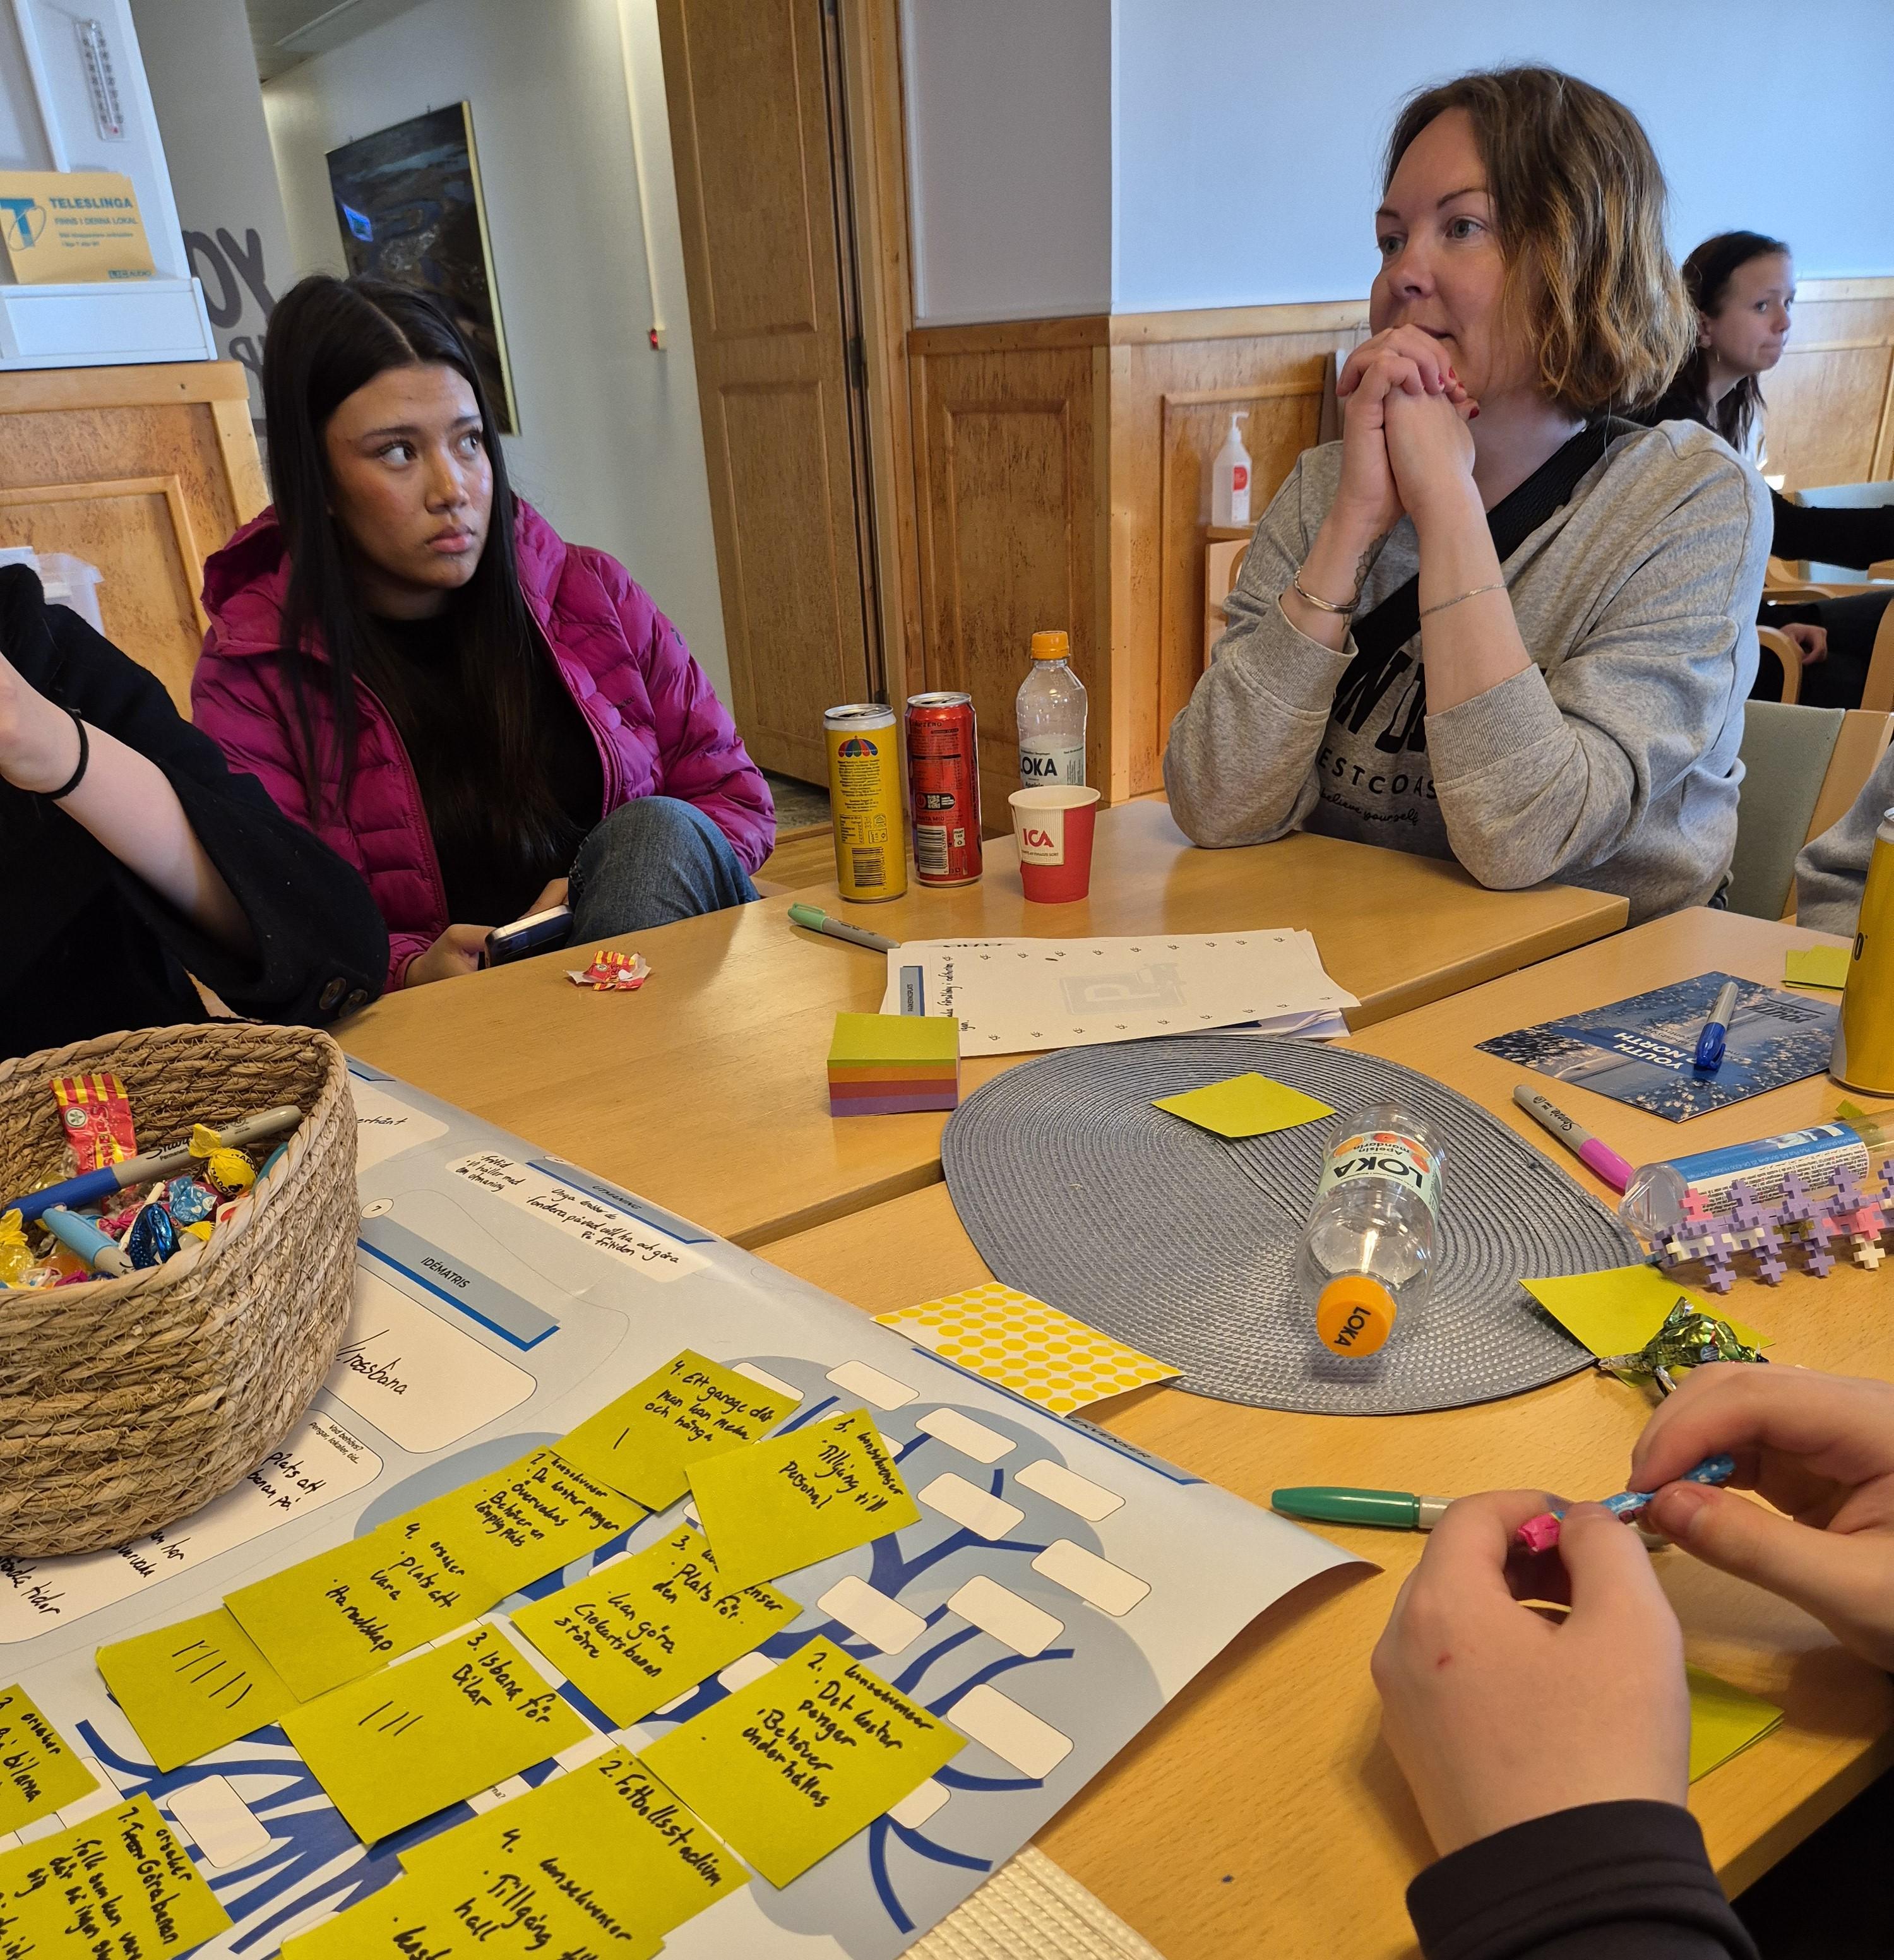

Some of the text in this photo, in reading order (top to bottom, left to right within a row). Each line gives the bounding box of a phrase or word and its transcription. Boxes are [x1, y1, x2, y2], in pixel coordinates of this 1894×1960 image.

[49, 198, 133, 209] TELESLINGA
[1021, 756, 1058, 776] OKA
[1318, 747, 1438, 799] ESTCOAS
[1364, 808, 1419, 826] yourself
[1023, 828, 1054, 847] ICA
[1613, 1033, 1688, 1059] NORTH
[1613, 1043, 1684, 1070] YOUTH
[1353, 1141, 1410, 1153] mandarin
[1359, 1146, 1403, 1155] Apelsin
[1333, 1156, 1423, 1189] LOKA
[592, 1185, 642, 1209] UTMANING
[420, 1257, 471, 1289] IDÉMATRIS
[1335, 1306, 1372, 1347] LOKA
[336, 1329, 410, 1396] rossbana
[645, 1401, 670, 1419] och
[697, 1385, 749, 1414] garage
[308, 1421, 330, 1442] Pengar,
[328, 1434, 348, 1457] lokaler,
[328, 1423, 365, 1452] Vad behövs?
[778, 1459, 834, 1510] Personal
[670, 1534, 691, 1551] 3.
[466, 1631, 489, 1652] 3.
[452, 1663, 494, 1707] Bilar
[818, 1680, 855, 1712] Det
